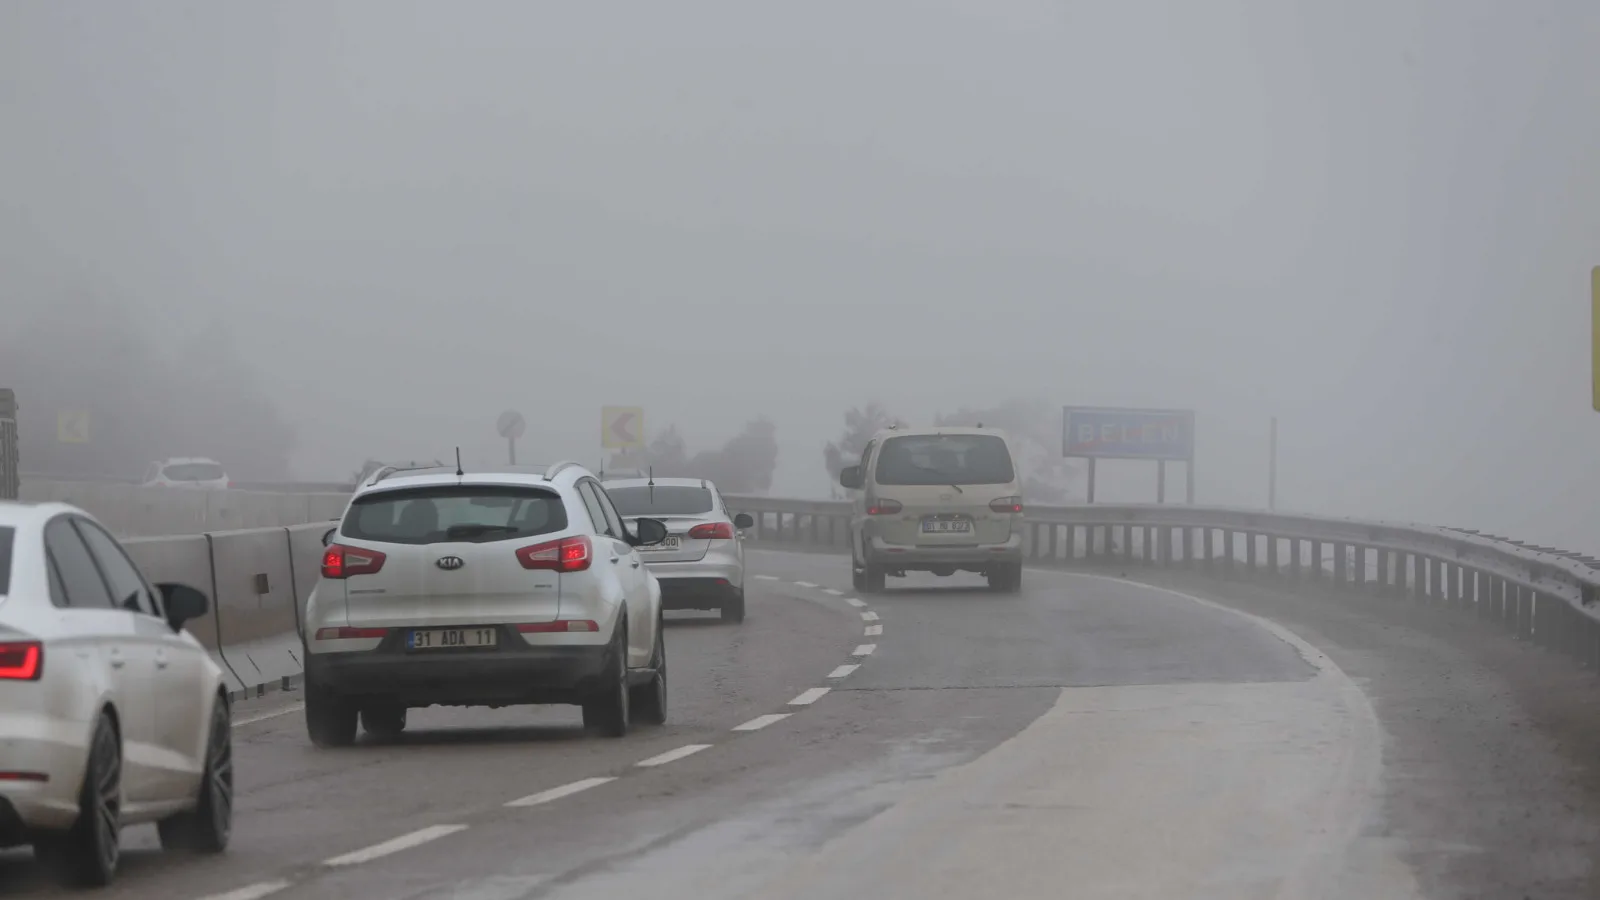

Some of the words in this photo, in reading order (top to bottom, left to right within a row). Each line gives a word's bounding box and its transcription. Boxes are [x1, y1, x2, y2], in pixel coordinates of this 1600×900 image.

[1077, 422, 1179, 444] BELEN
[439, 557, 460, 568] KIA
[414, 631, 431, 647] 31
[441, 630, 467, 646] ADA
[476, 629, 491, 645] 11
